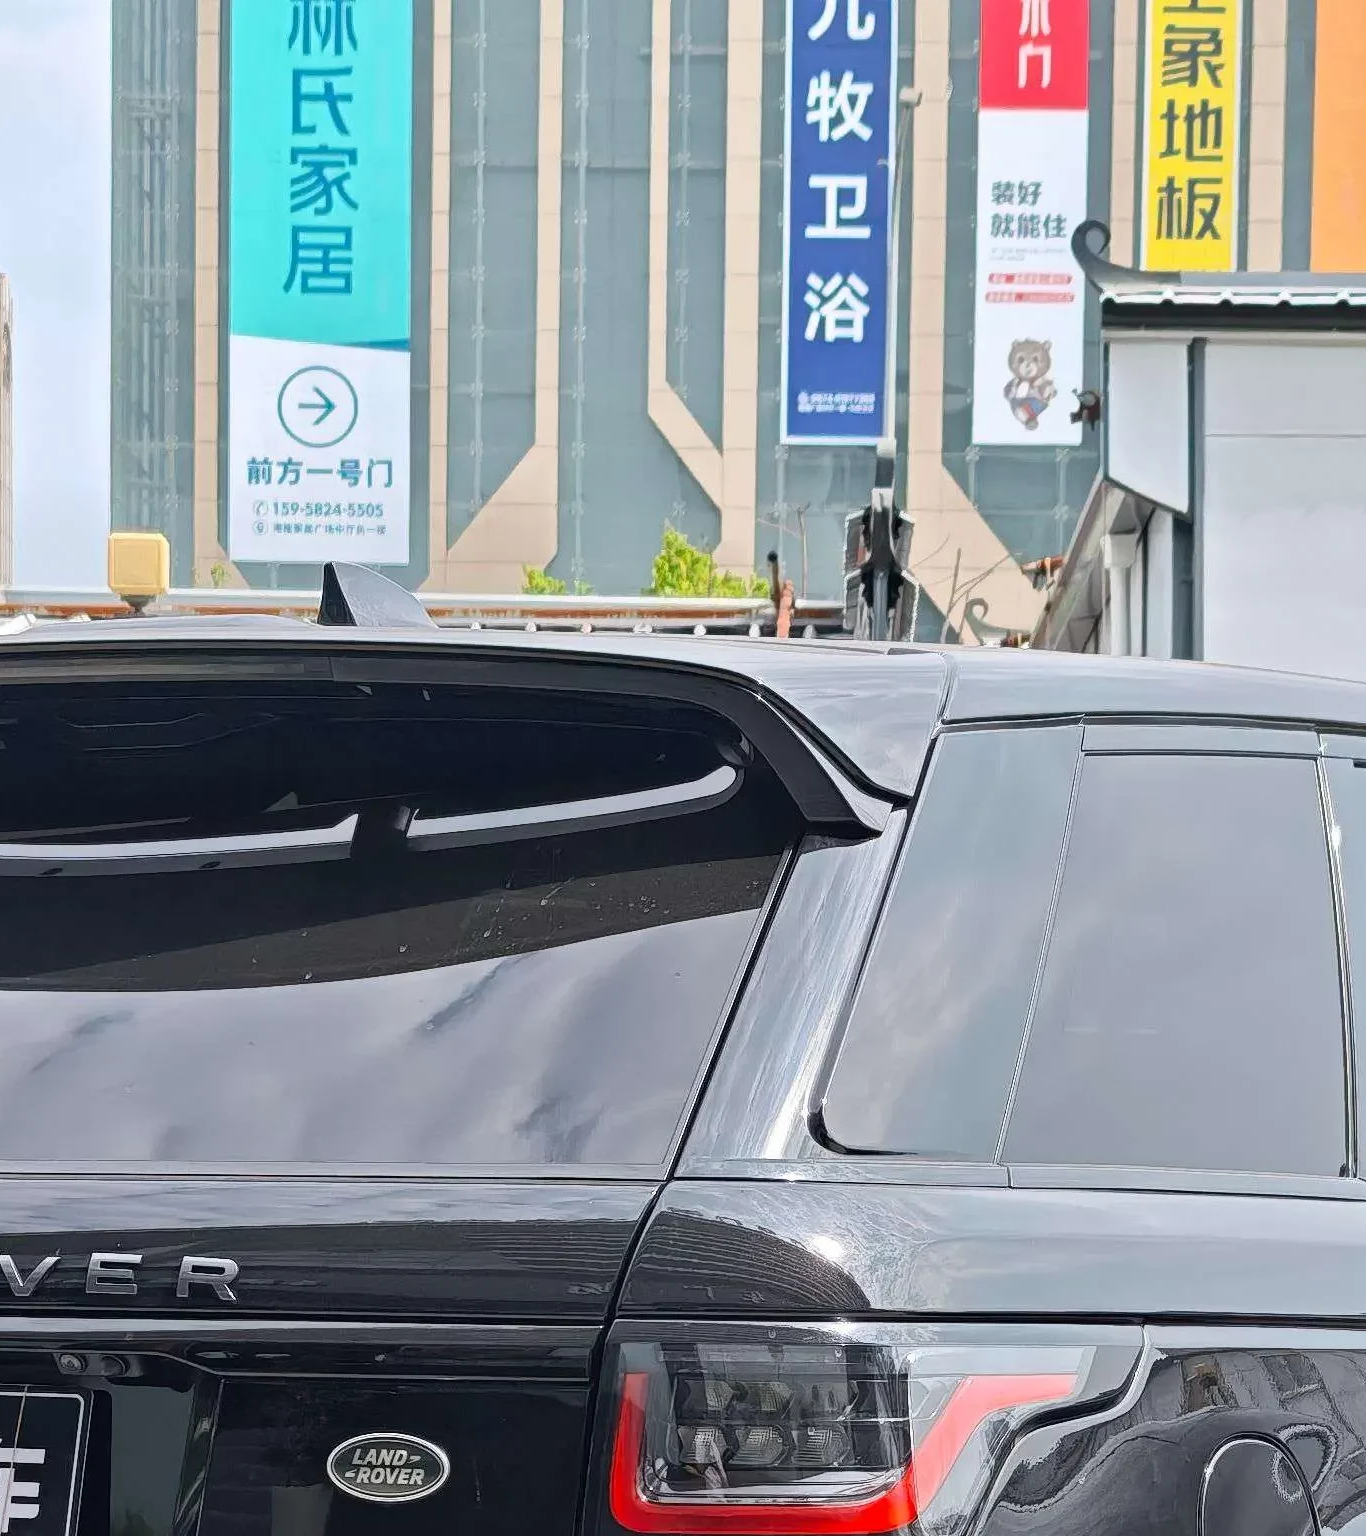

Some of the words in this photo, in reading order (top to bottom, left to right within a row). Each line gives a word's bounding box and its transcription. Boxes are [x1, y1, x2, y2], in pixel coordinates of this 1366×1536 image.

[1155, 0, 1227, 241] 象地板
[283, 0, 359, 296] 林氏家居
[990, 213, 1067, 239] 就能住
[246, 456, 393, 488] 前方一号门
[352, 1448, 408, 1466] LAND
[356, 1467, 425, 1485] ROVER
